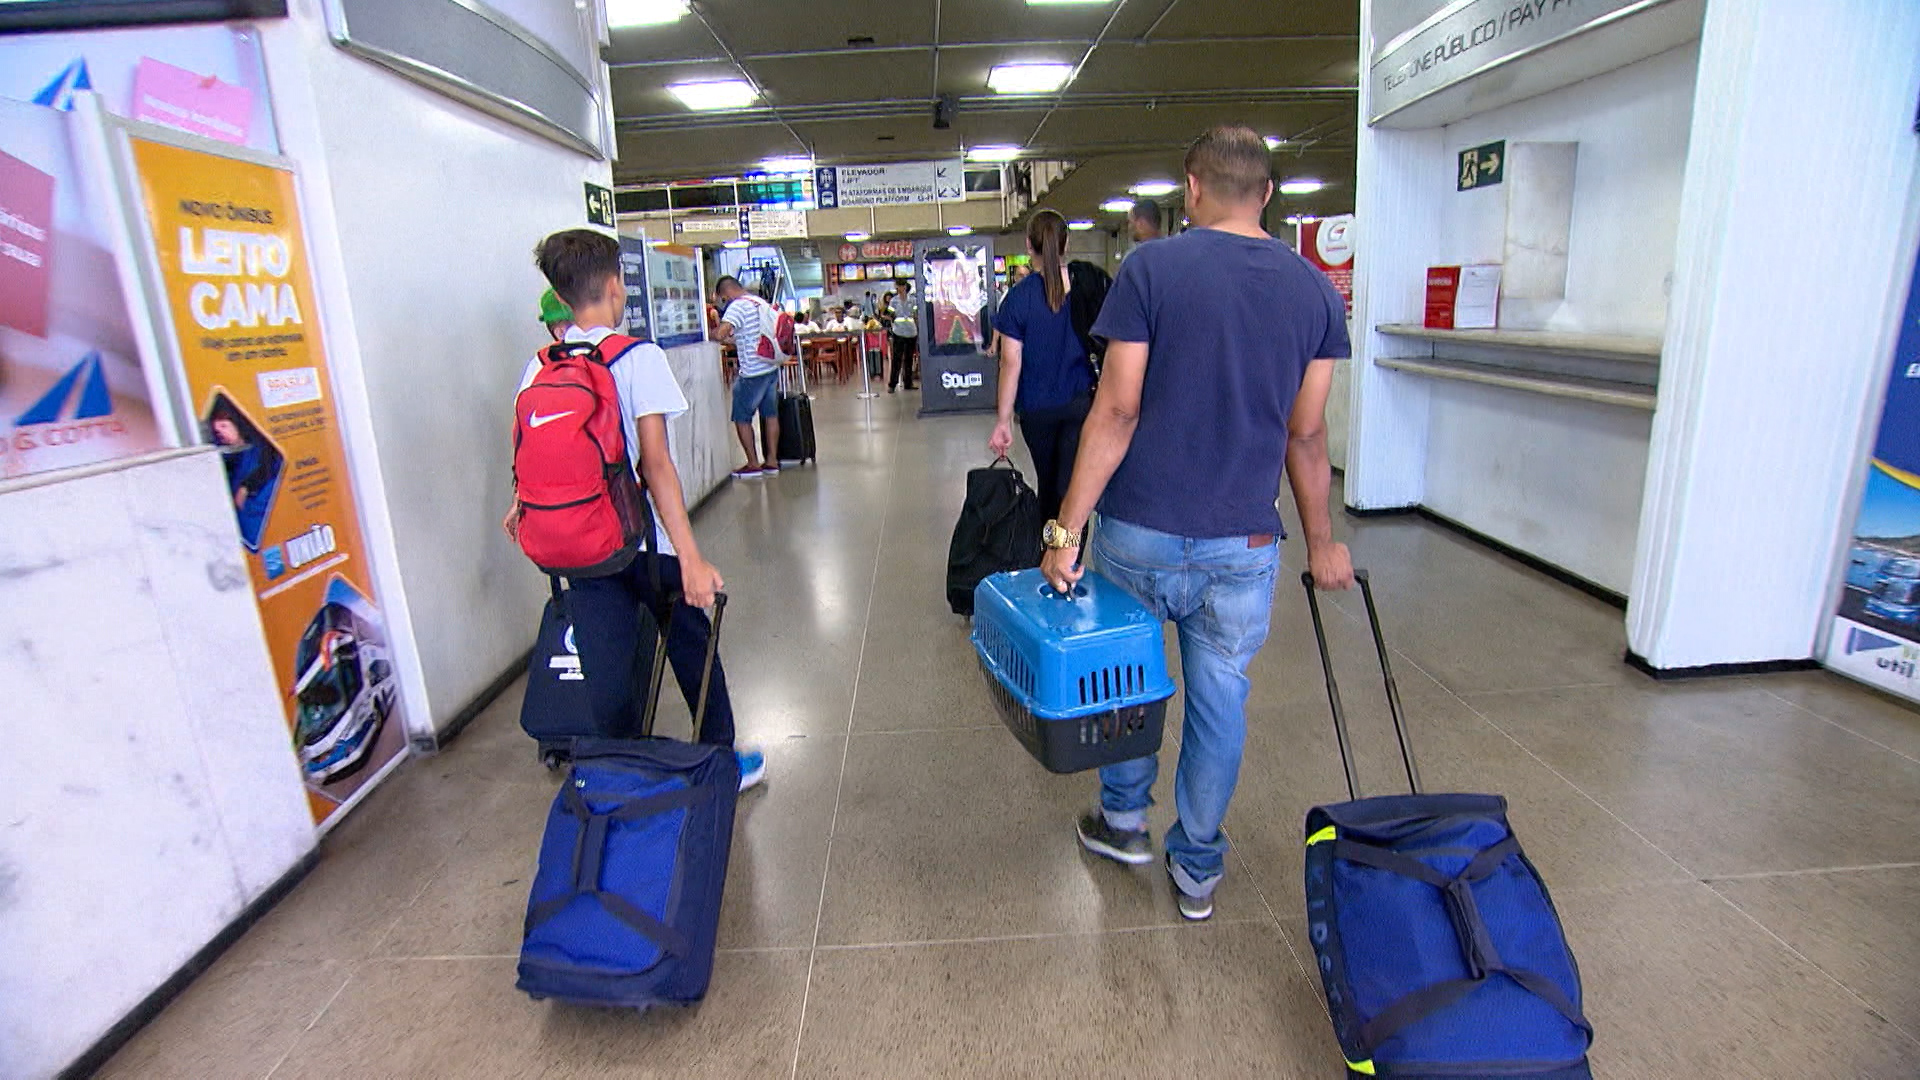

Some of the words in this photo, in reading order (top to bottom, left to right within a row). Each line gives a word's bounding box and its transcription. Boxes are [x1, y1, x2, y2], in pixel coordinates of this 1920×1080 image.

[1433, 18, 1496, 65] PÚBLICO
[841, 167, 886, 176] ELEVADOR
[841, 187, 887, 196] PLATAFORMAS
[875, 195, 910, 204] PLATFORM
[180, 200, 221, 219] NOVO
[179, 226, 290, 277] LEITO
[190, 281, 303, 330] CAMA
[1876, 656, 1916, 678] util
